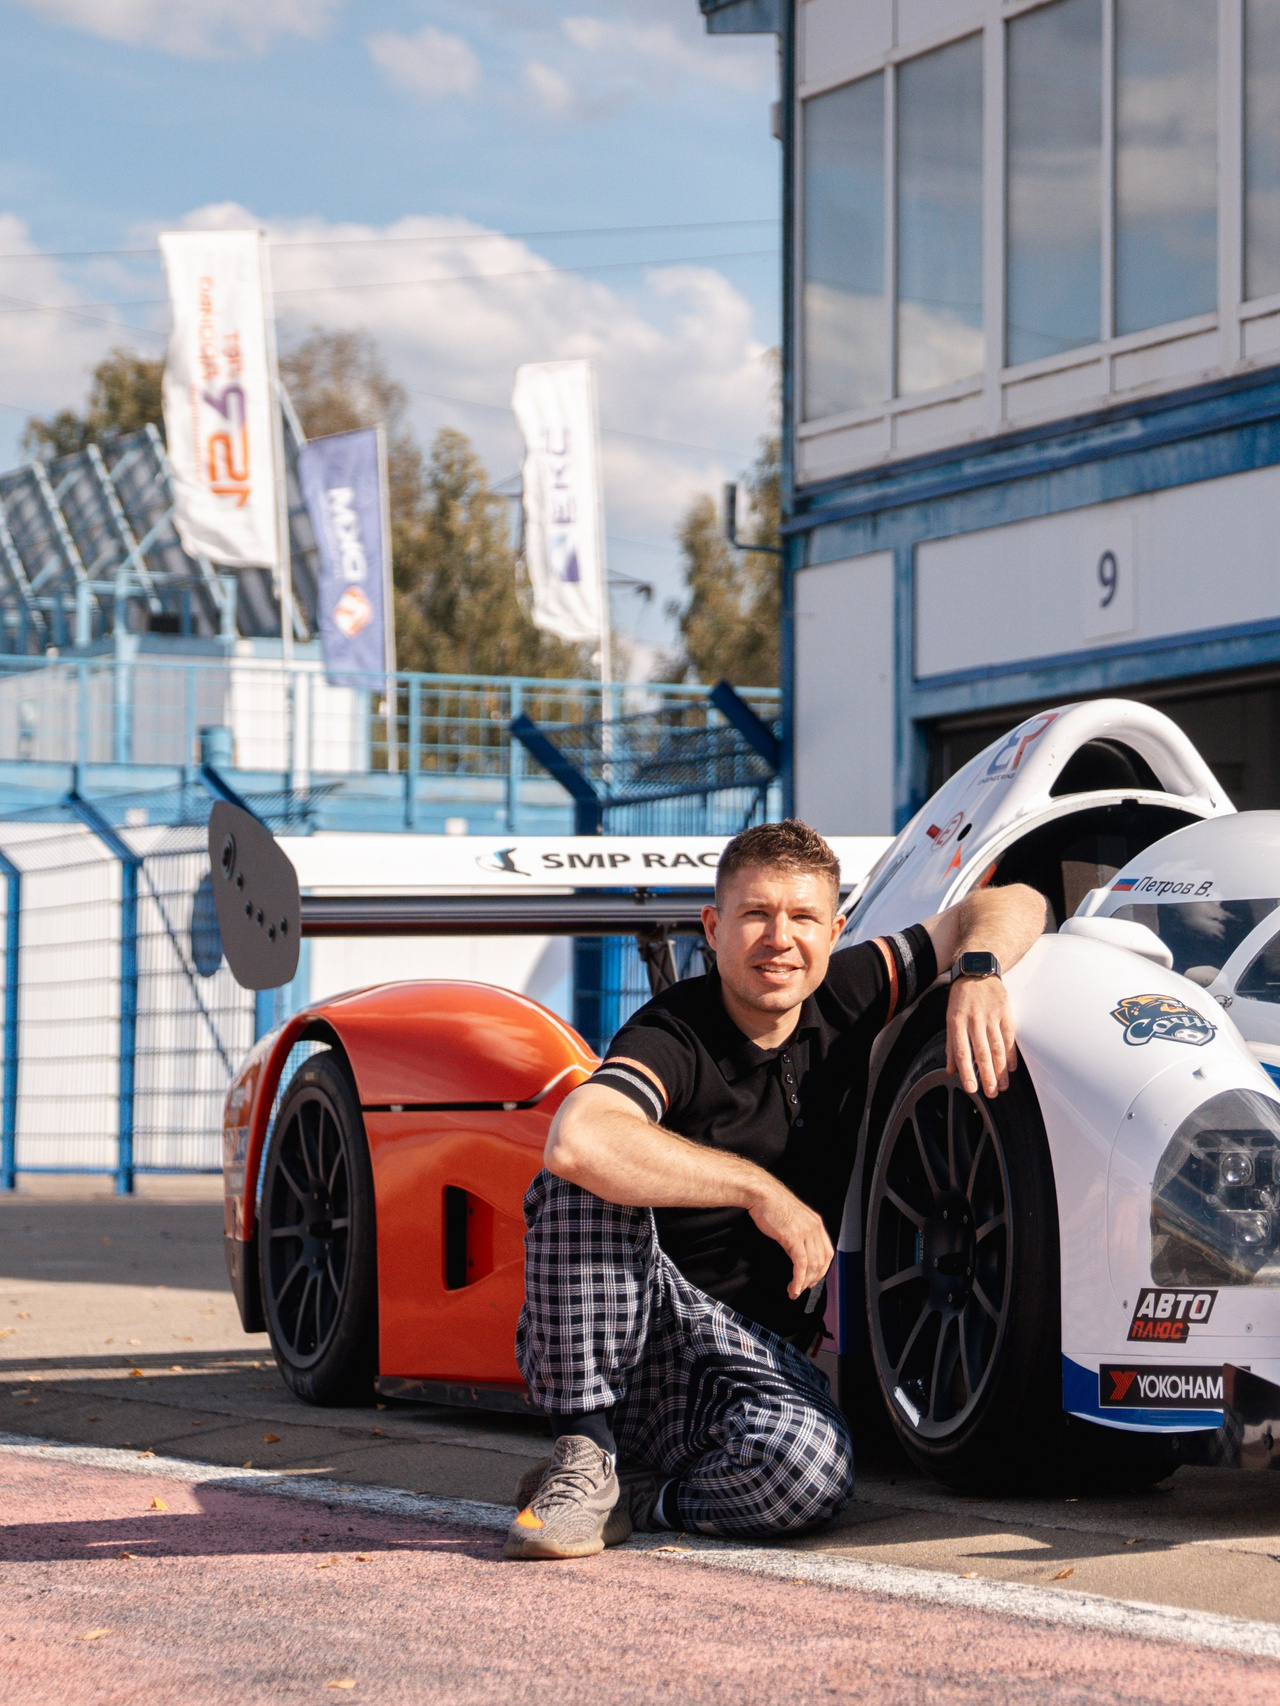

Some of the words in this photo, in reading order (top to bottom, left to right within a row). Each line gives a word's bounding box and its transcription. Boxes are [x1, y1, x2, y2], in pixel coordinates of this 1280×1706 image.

[1098, 549, 1118, 609] 9
[541, 852, 631, 869] SMP
[1134, 876, 1195, 897] Петров
[1194, 881, 1214, 898] В.
[1136, 1292, 1213, 1320] АВТО
[1131, 1321, 1184, 1340] ПЛЮС
[1136, 1375, 1224, 1400] YOKOHAM
